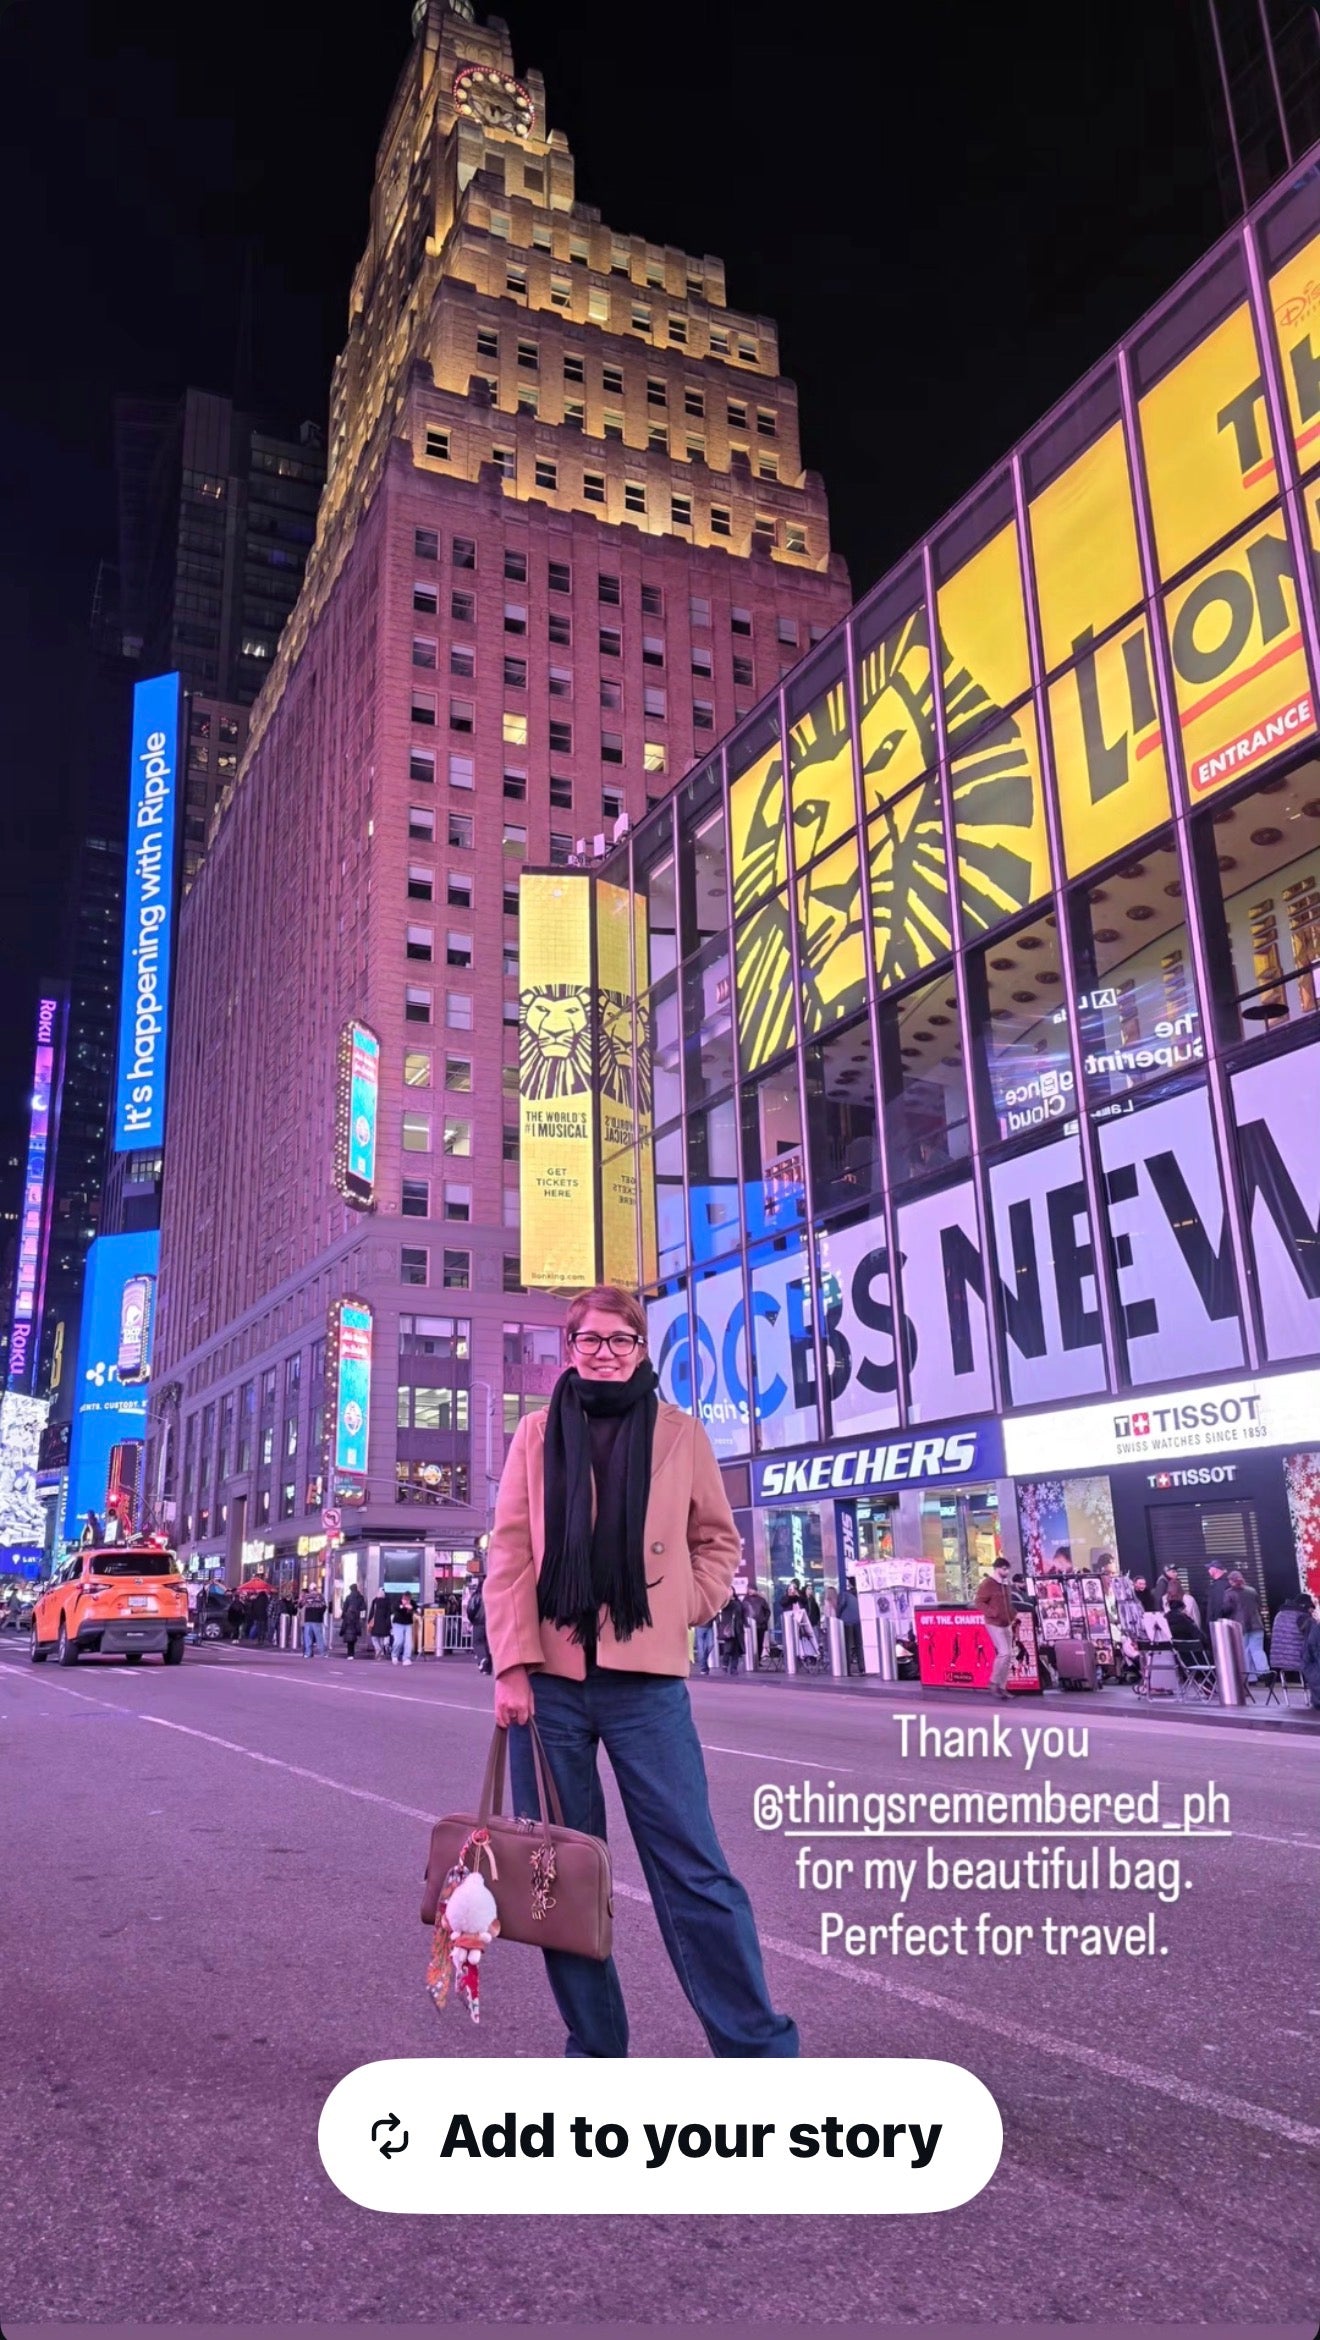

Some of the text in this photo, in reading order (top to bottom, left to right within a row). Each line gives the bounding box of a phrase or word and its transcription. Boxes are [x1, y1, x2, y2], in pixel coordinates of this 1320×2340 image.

[1198, 699, 1311, 786] ENTRANCE
[124, 731, 171, 1132] It's happening with Ripple
[526, 1111, 587, 1124] THE WORLD'S
[538, 1123, 588, 1139] MUSICAL
[536, 1178, 579, 1187] TICKETS
[547, 1168, 567, 1176] GET
[544, 1189, 571, 1198] HERE
[722, 1246, 918, 1420] CBS
[1153, 1395, 1261, 1432] TISSOT
[1116, 1425, 1268, 1454] SWISS WATCHES SINCE 1853
[760, 1431, 978, 1497] SKECHERS
[1170, 1465, 1237, 1487] TISSOT
